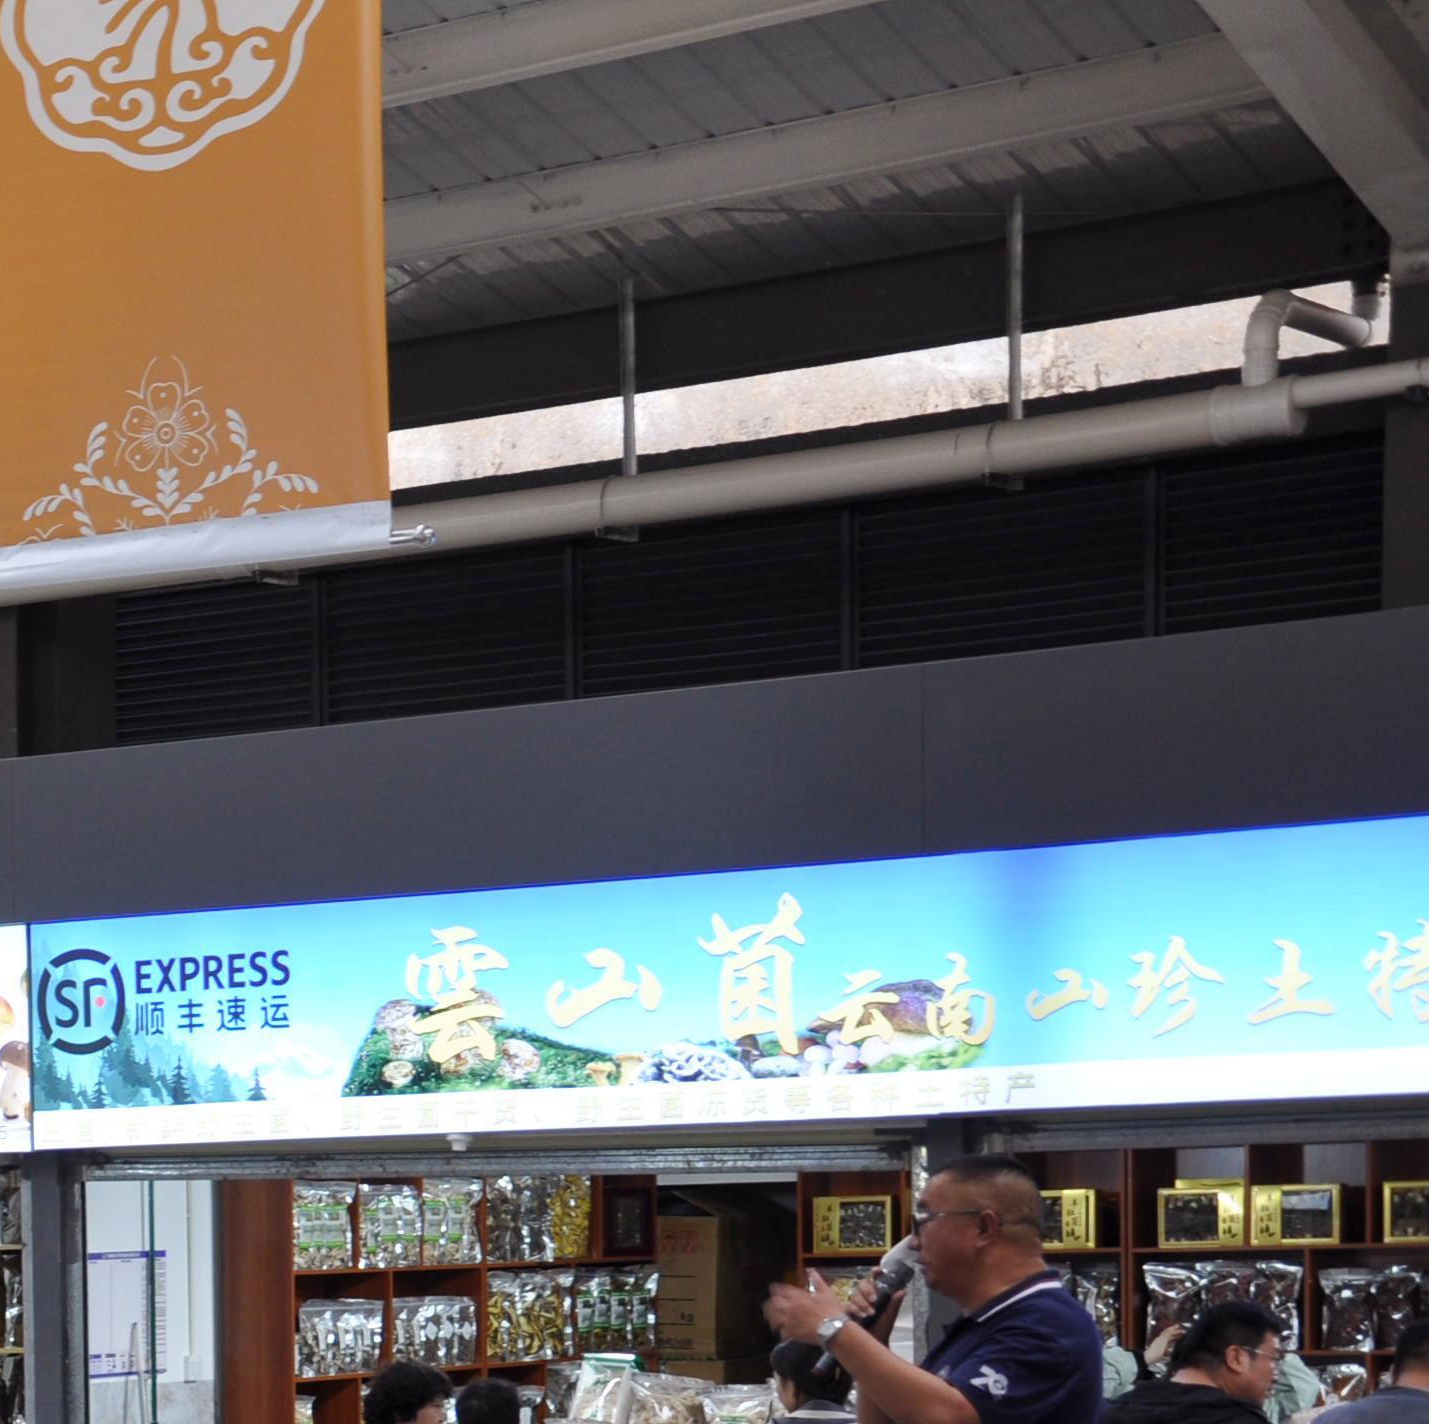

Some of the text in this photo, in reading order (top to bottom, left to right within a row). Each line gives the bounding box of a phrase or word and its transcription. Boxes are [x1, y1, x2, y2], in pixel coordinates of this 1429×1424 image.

[134, 949, 291, 995] EXPRESS
[133, 994, 291, 1037] 顺丰速运
